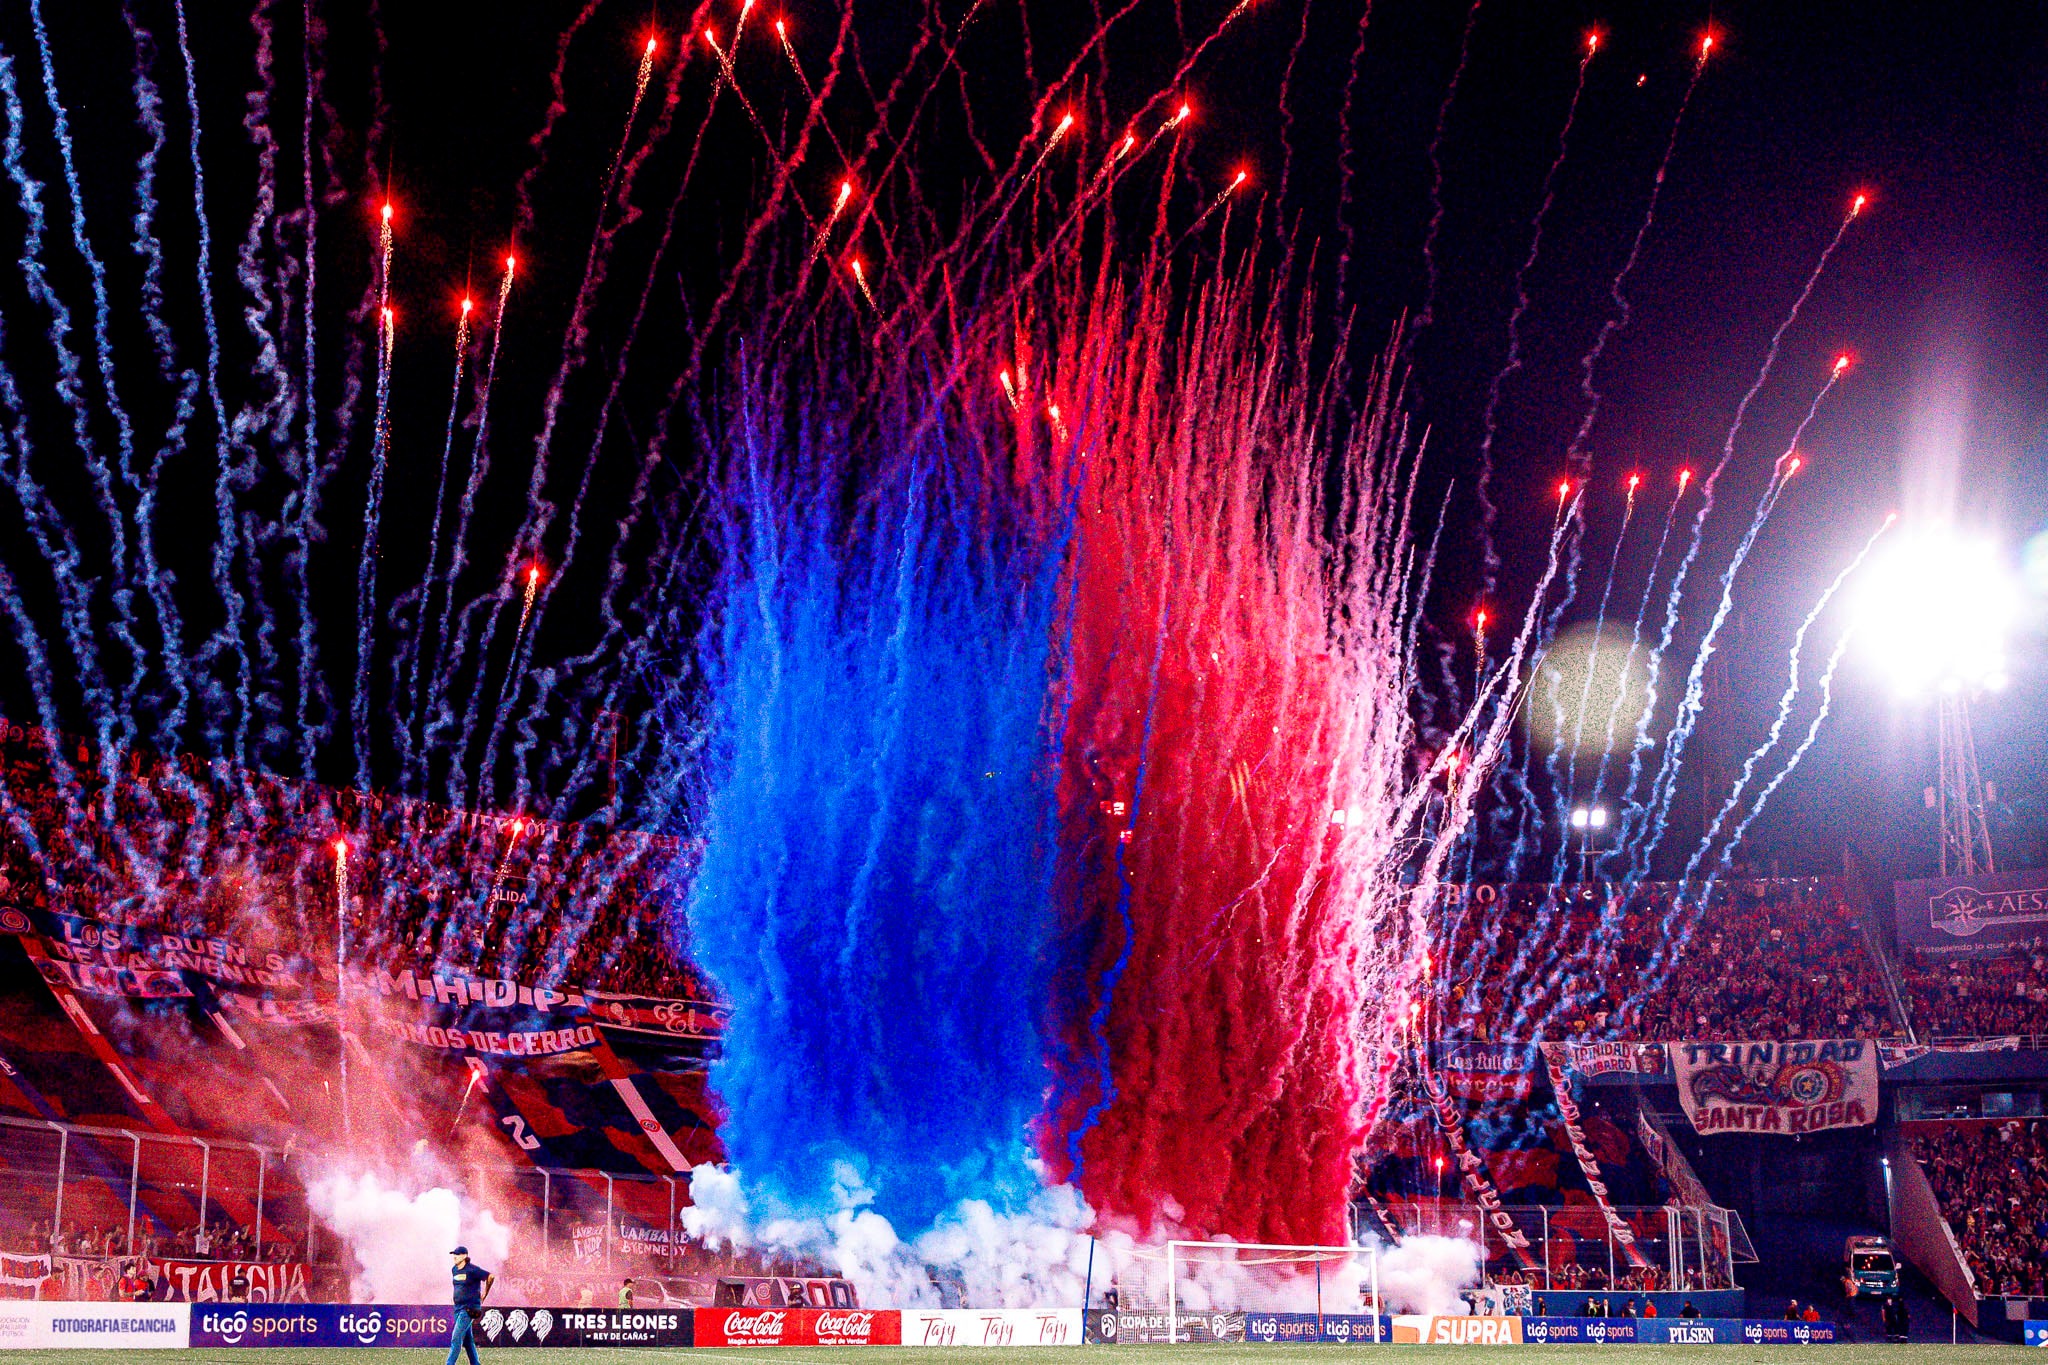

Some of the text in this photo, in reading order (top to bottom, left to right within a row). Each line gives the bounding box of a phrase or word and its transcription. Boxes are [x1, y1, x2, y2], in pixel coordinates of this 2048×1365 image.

[653, 1001, 703, 1035] El
[468, 1030, 508, 1055] DE
[508, 1025, 596, 1056] CERRO
[1571, 1043, 1631, 1061] TRINIDAD
[1682, 1041, 1863, 1066] TRINIDAD
[1577, 1059, 1632, 1076] OMBARDO
[1695, 1100, 1866, 1133] SANTA ROSA
[52, 1318, 120, 1333] FOTOGRAFIA
[130, 1318, 176, 1333] CANCHA
[252, 1318, 317, 1340] sports
[386, 1319, 447, 1339] sports
[562, 1313, 678, 1334] TRES LEONES
[723, 1311, 787, 1336] Coca-Cola
[814, 1311, 875, 1336] Coca-Cola
[919, 1317, 957, 1346] Tajy
[979, 1316, 1015, 1345] Tajy
[1035, 1315, 1069, 1345] Tajy
[1120, 1316, 1149, 1329] COPA
[1150, 1316, 1164, 1329] DE
[1279, 1322, 1315, 1337] sports
[1351, 1323, 1386, 1339] spors
[1433, 1319, 1513, 1343] SUPRA
[1549, 1324, 1578, 1338] sports
[1608, 1325, 1634, 1338] sports
[593, 1331, 648, 1341] REY DE CAÑAS
[1668, 1327, 1714, 1343] PILSEN
[1763, 1328, 1788, 1340] sports
[1811, 1328, 1834, 1340] sports
